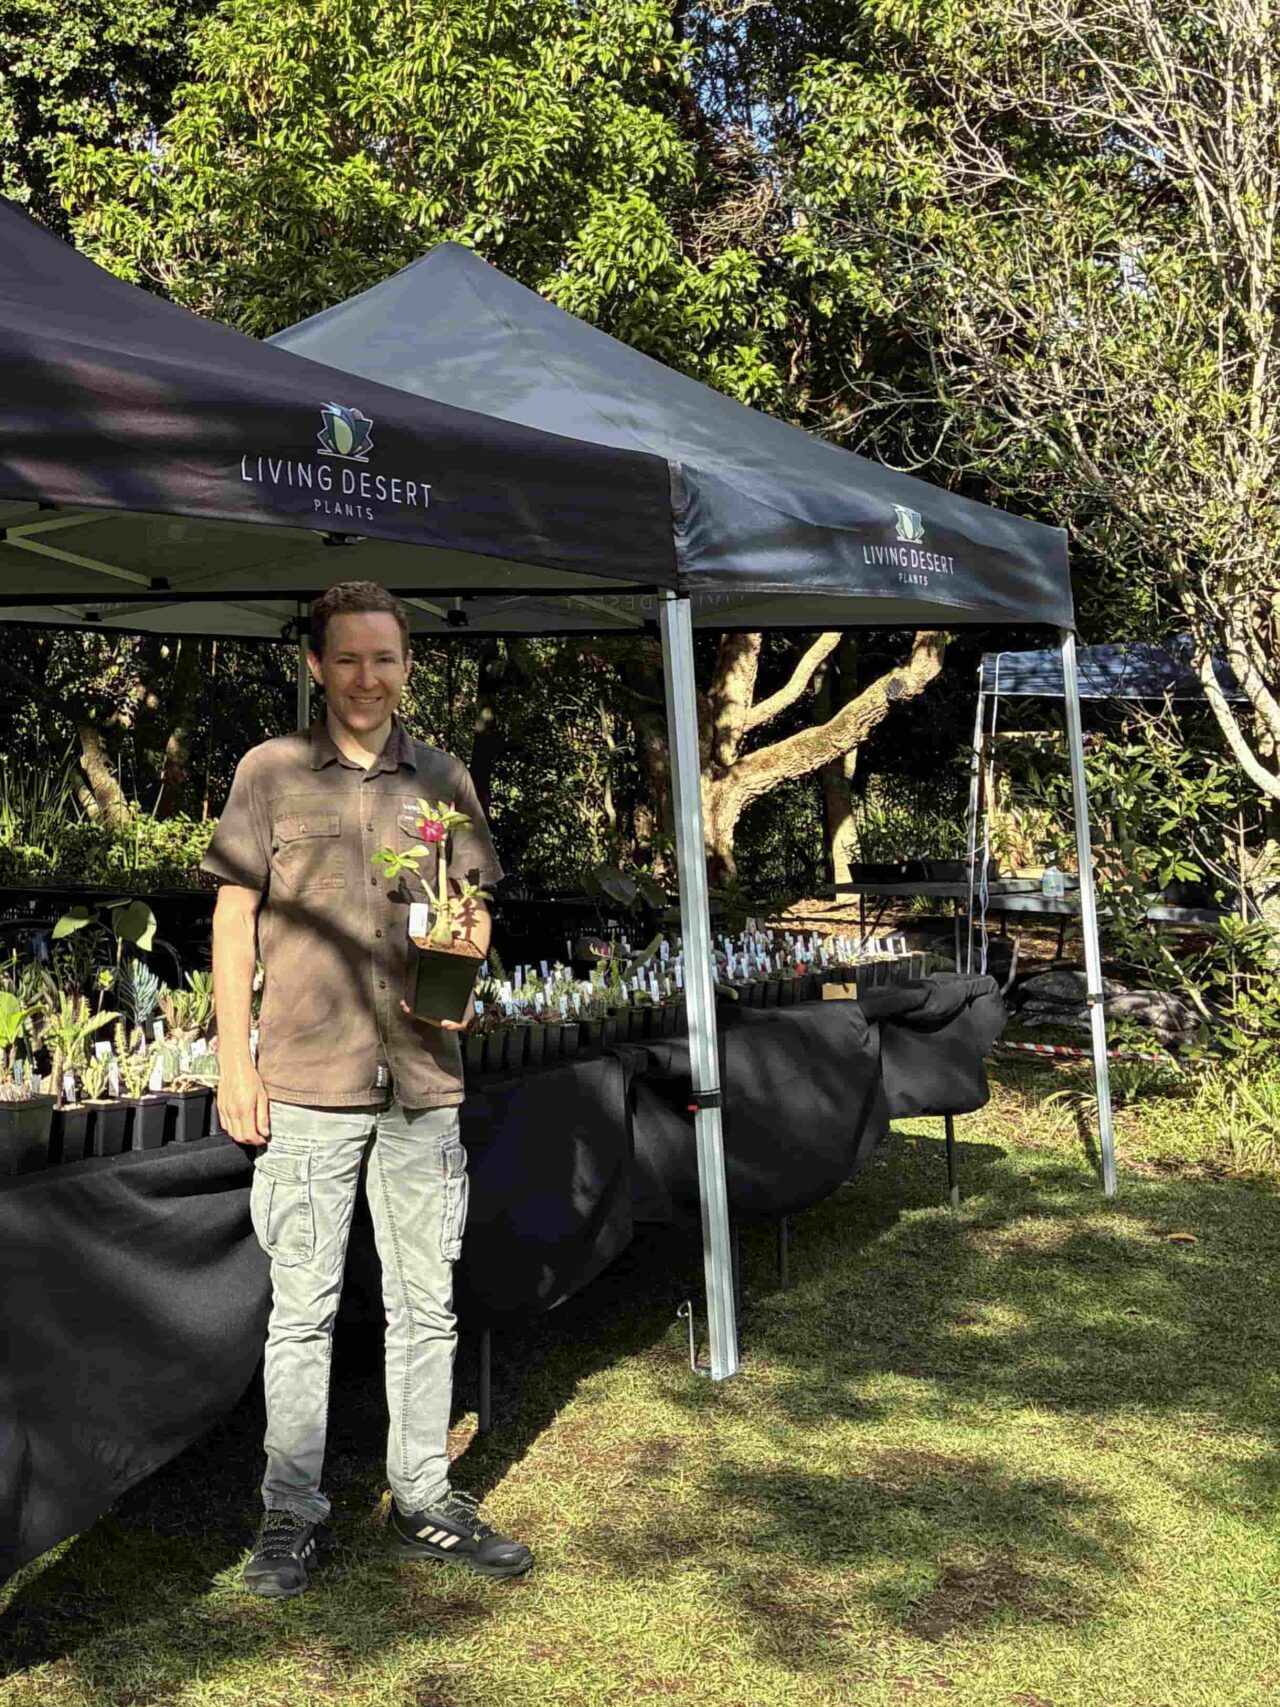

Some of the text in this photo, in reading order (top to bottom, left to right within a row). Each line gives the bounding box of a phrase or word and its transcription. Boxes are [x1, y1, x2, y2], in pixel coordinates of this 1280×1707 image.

[241, 454, 433, 508] LIVING DESERT
[314, 499, 375, 521] PLANTS
[863, 545, 954, 575] LIVING DESERT
[899, 572, 929, 586] PLANTS
